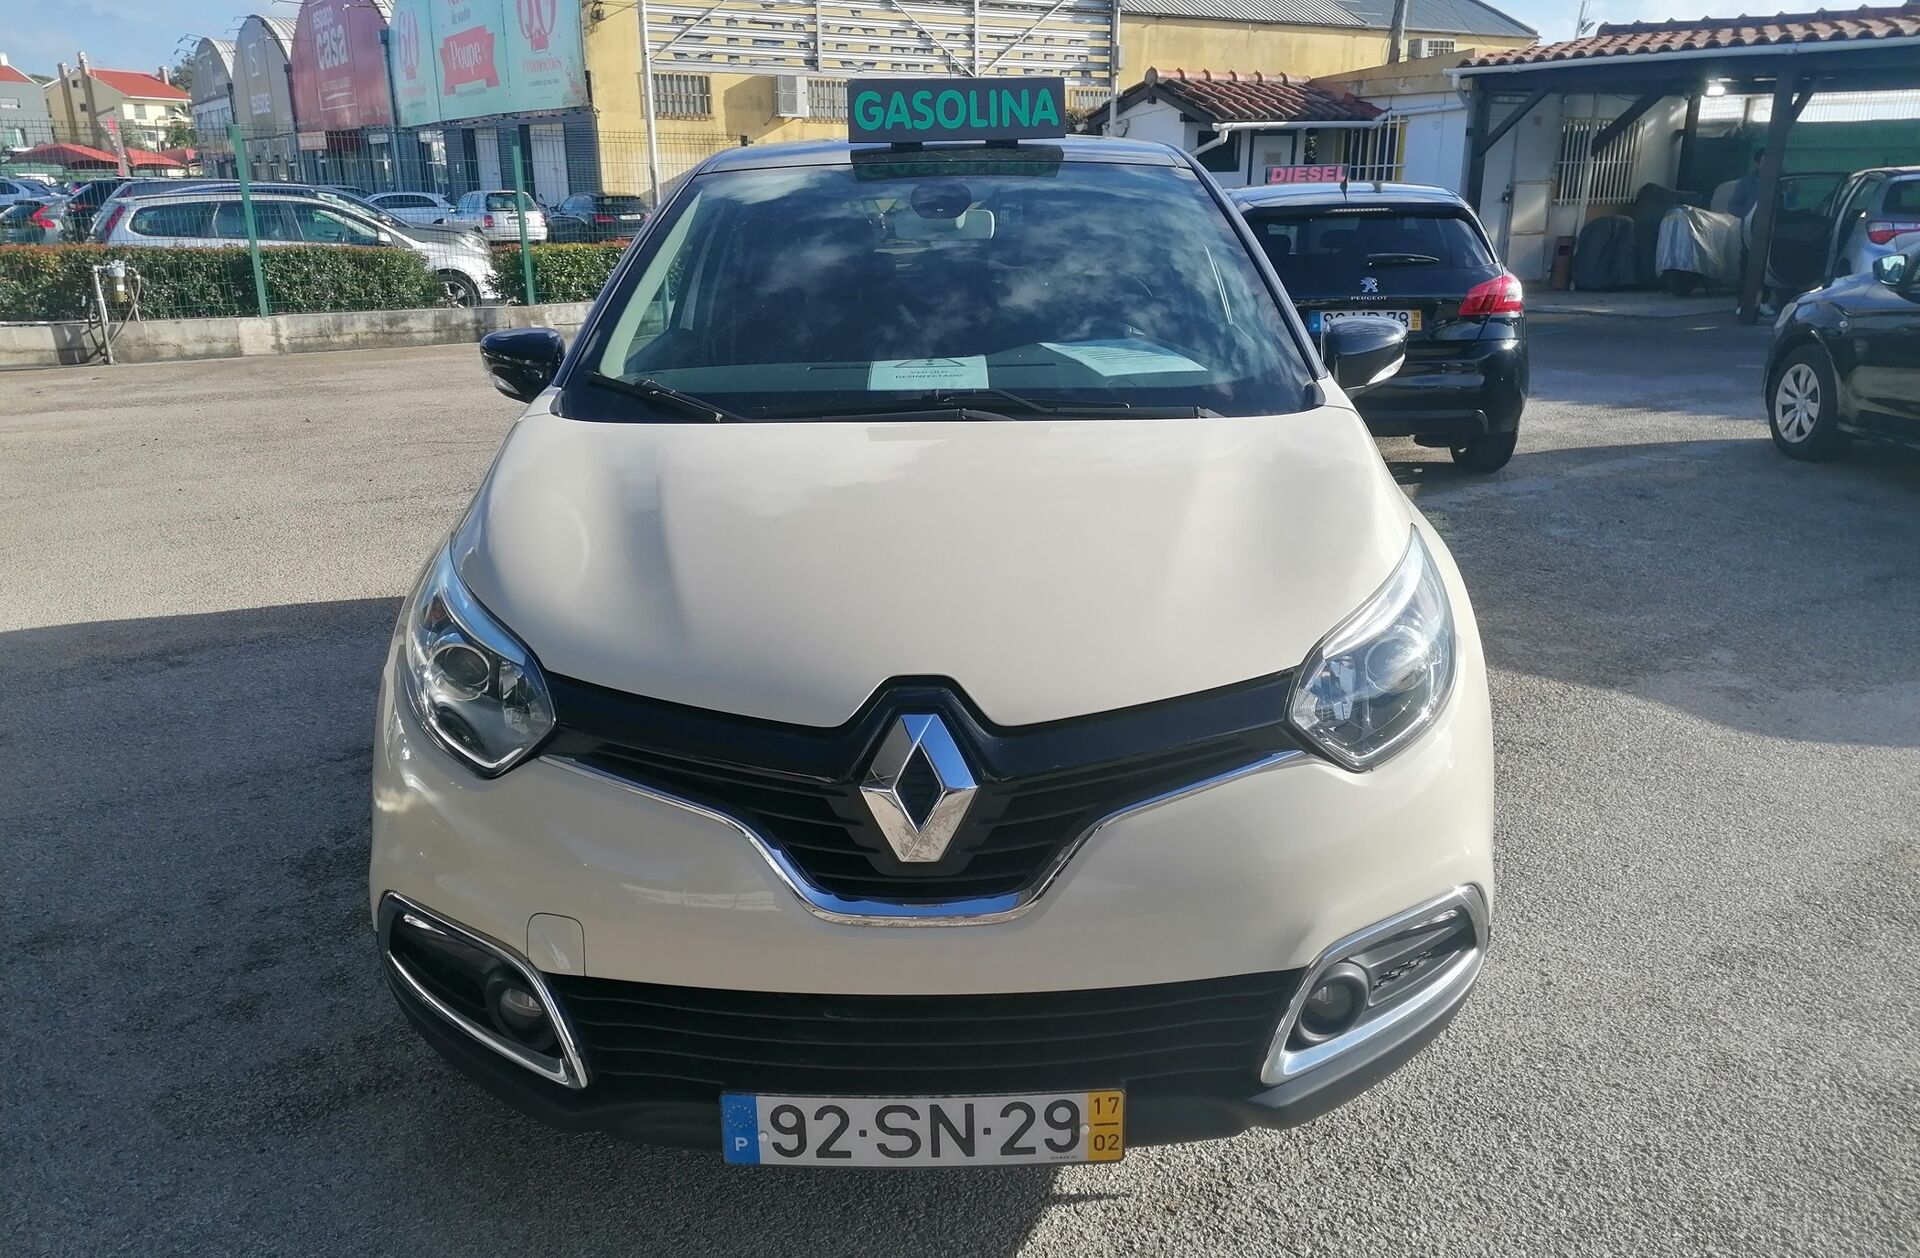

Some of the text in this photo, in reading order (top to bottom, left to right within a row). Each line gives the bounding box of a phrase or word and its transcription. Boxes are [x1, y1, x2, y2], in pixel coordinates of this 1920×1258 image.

[316, 24, 348, 70] casa
[449, 41, 482, 75] Poupe
[854, 88, 1060, 131] GASOLINA
[1271, 165, 1346, 184] DIESEL
[1093, 1096, 1120, 1116] 17
[735, 1137, 748, 1152] P
[1093, 1133, 1120, 1152] 02
